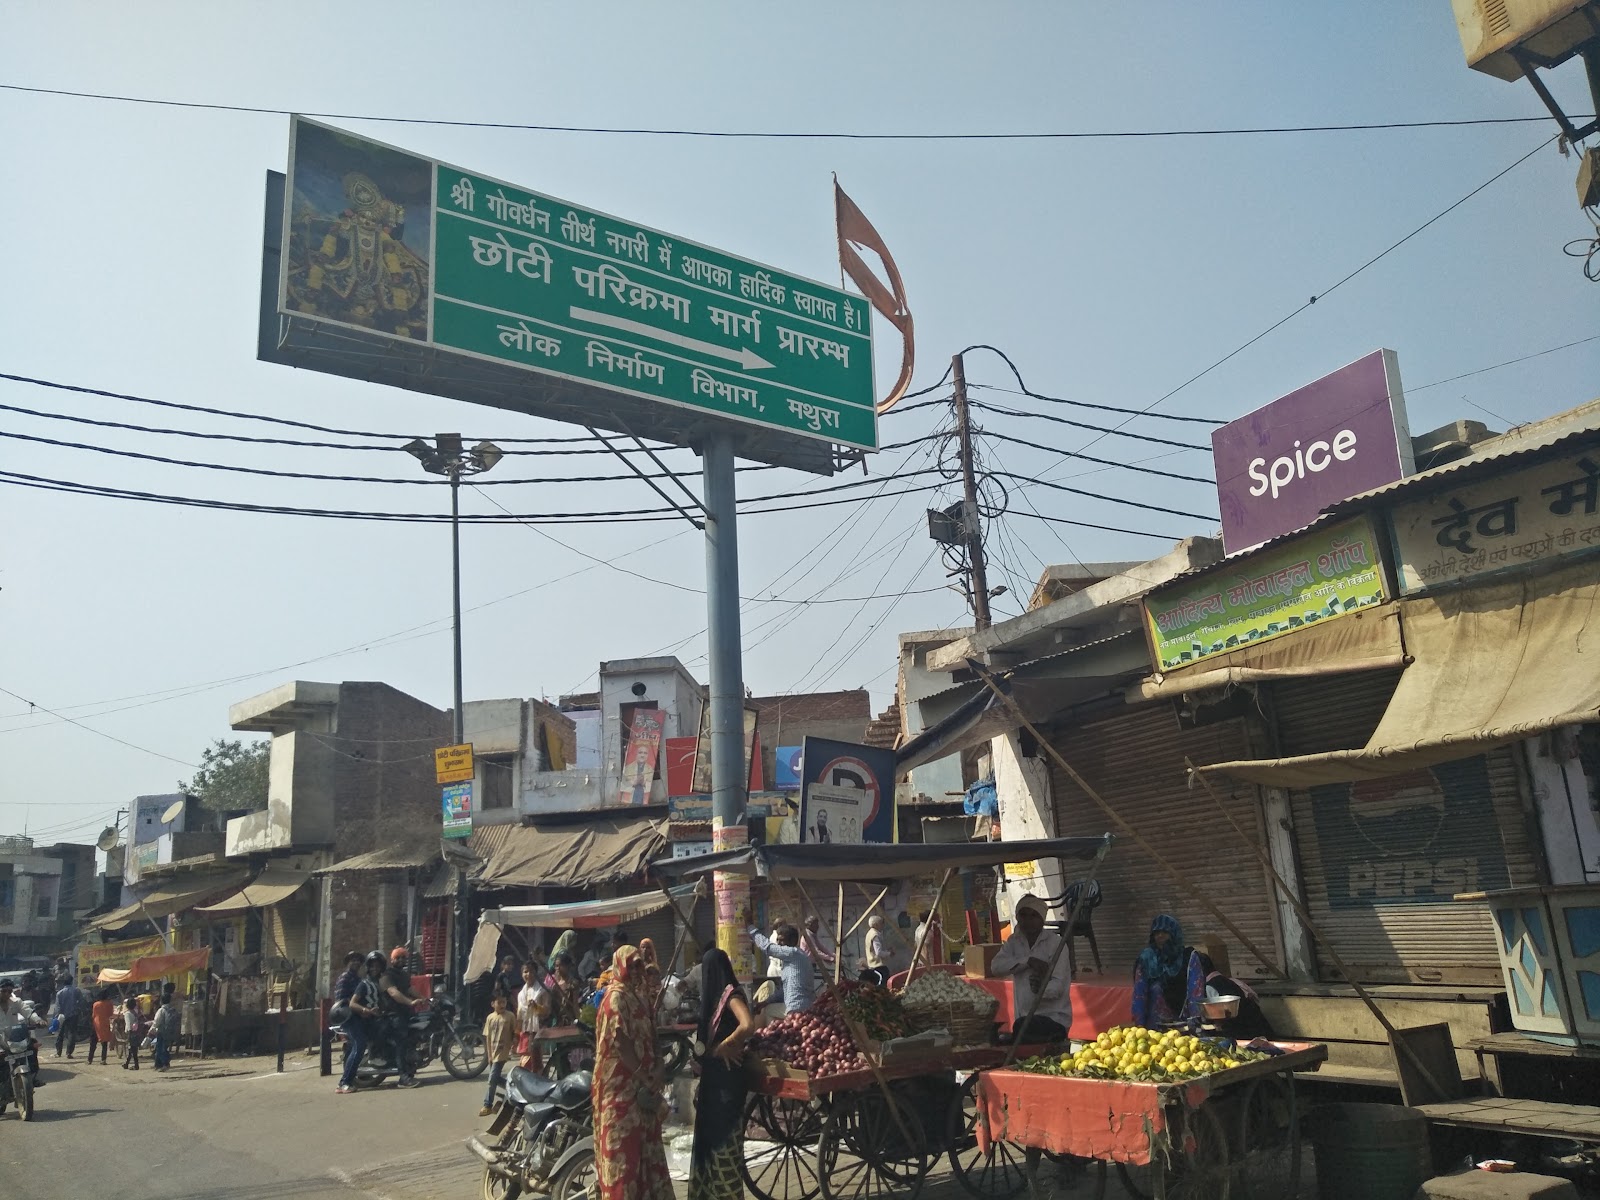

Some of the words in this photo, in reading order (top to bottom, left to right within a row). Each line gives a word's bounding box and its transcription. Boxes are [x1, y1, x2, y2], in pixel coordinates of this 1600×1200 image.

[450, 178, 475, 211] श्री
[486, 189, 550, 233] गोवर्धन
[560, 211, 596, 247] तीर्थ
[605, 231, 649, 263] नगरी
[658, 239, 673, 271] में
[682, 255, 732, 290] आपका
[740, 271, 786, 305] हार्दिक
[793, 290, 837, 322] स्वागत
[843, 299, 862, 330] है।
[469, 232, 554, 285] छोटी
[572, 263, 691, 324] परिक्रमा
[707, 306, 762, 344] मार्ग
[776, 325, 850, 369] प्रारम्भ
[496, 321, 562, 357] लोक
[585, 340, 665, 385] निर्माण
[691, 368, 765, 413] विभाग,
[787, 398, 840, 431] मथुरा
[1249, 430, 1356, 498] Spice
[1431, 496, 1518, 554] देव
[1541, 457, 1600, 514] मे
[1156, 593, 1226, 633] आदित्य
[1227, 560, 1314, 607] मोबाइल
[1317, 537, 1369, 577] शॉप
[1314, 583, 1335, 598] आदि
[1489, 546, 1508, 562] एवं
[1556, 528, 1577, 546] की
